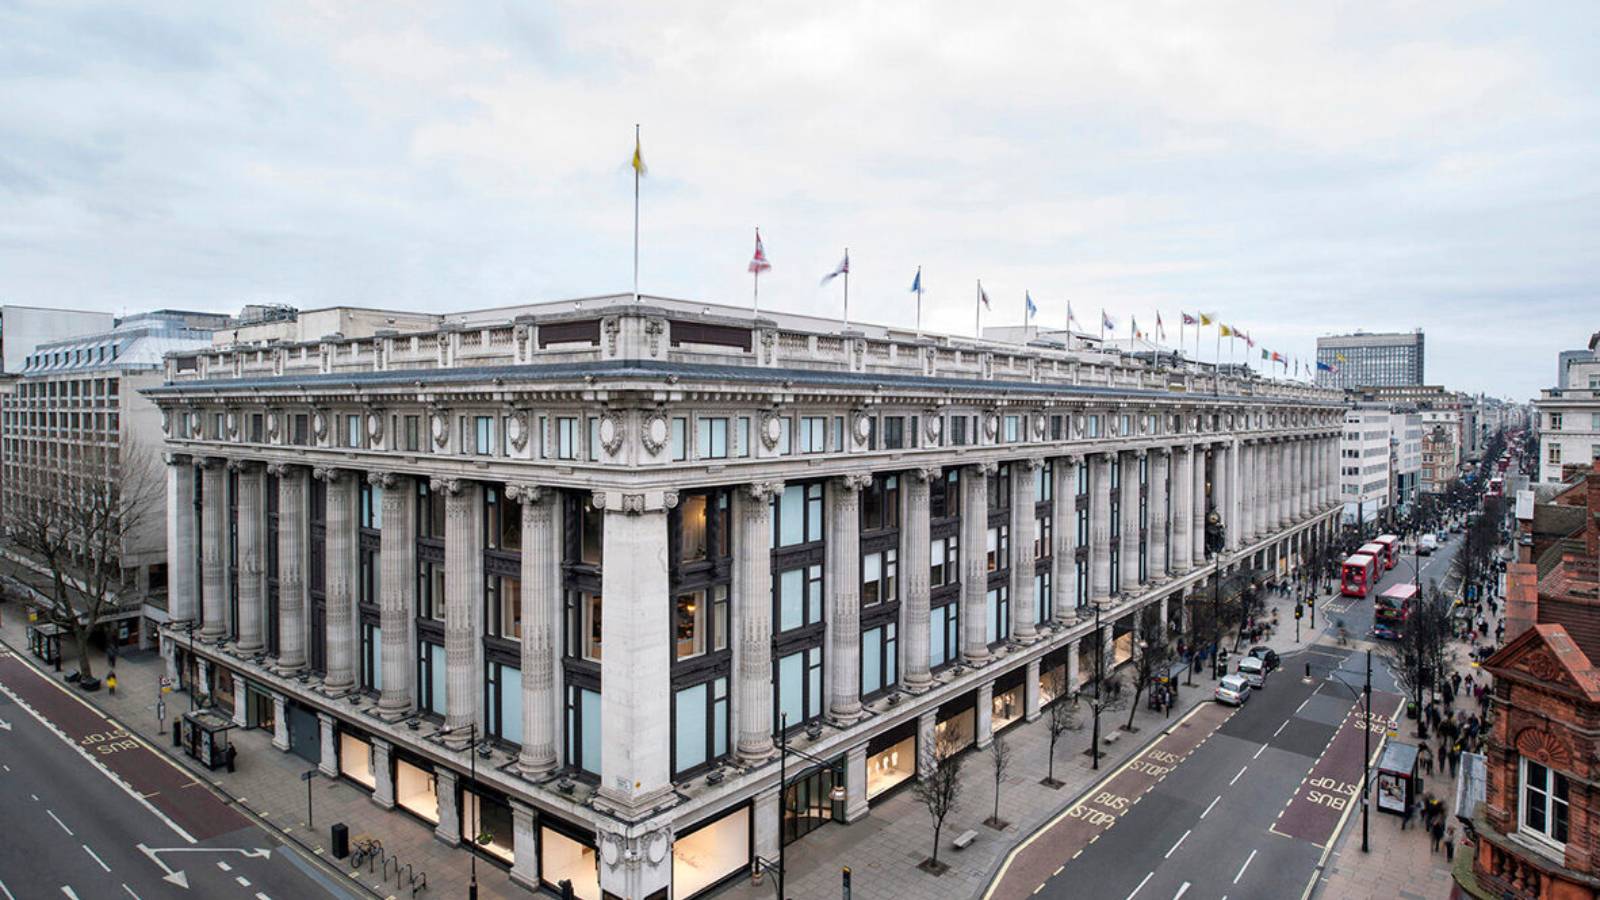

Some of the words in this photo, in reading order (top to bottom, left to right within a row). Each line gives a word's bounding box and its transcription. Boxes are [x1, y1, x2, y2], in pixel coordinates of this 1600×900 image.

[97, 740, 139, 754] BUS
[1148, 750, 1179, 763] BUS
[1130, 760, 1169, 777] STOP
[1309, 777, 1358, 796] STOP
[1094, 792, 1129, 809] BUS
[1306, 790, 1346, 810] BUS
[1070, 805, 1116, 826] STOP
